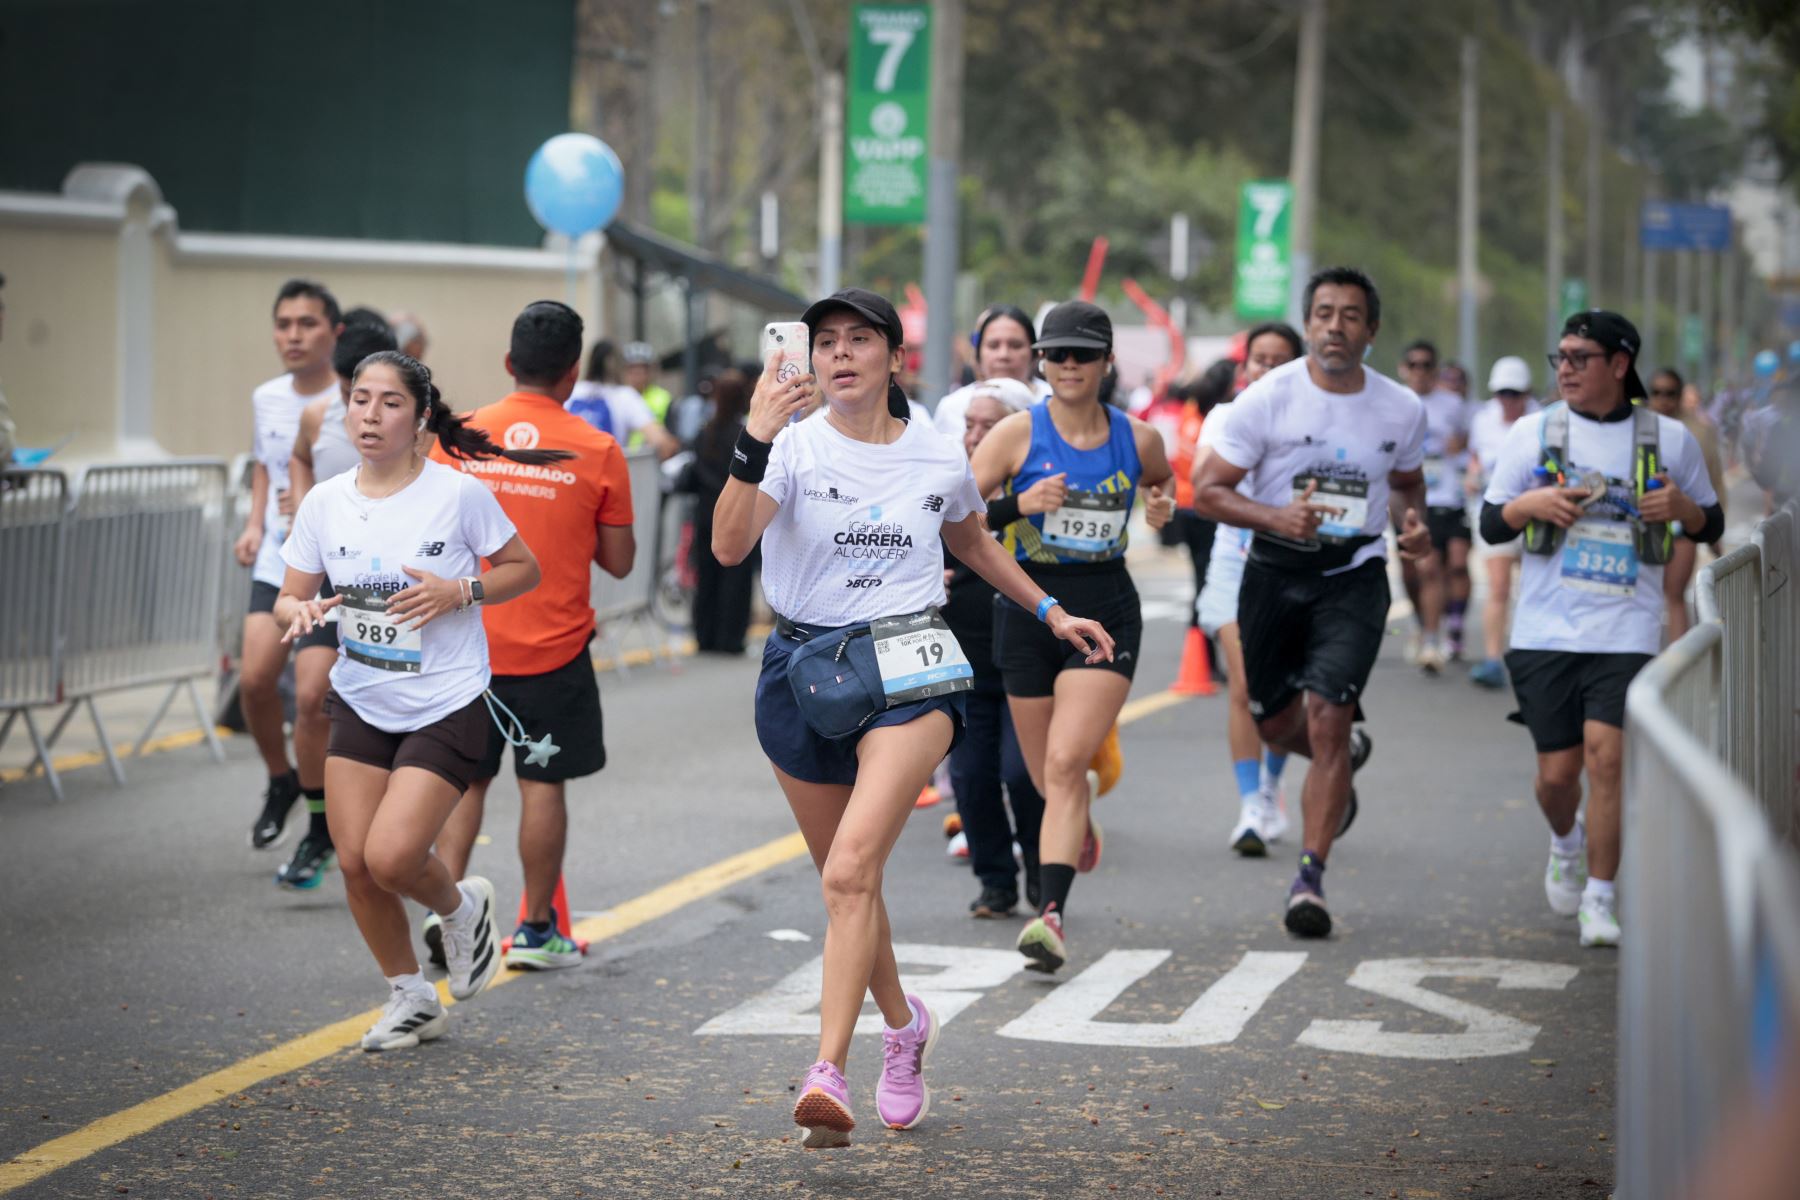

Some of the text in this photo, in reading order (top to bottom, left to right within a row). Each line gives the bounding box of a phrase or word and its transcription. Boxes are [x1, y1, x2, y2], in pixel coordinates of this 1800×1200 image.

[868, 30, 916, 94] 7
[1248, 192, 1285, 238] 7
[461, 460, 577, 485] VOLUNTARIADO
[501, 480, 556, 500] RUNNERS
[848, 521, 903, 534] ¡Gánale la
[1062, 520, 1111, 538] 1938
[833, 532, 913, 548] CARRERA
[834, 546, 909, 560] AL CÁNCER!
[1577, 551, 1628, 575] 3326
[357, 622, 398, 644] 989
[916, 642, 944, 667] 19
[694, 944, 1580, 1060] BUS
